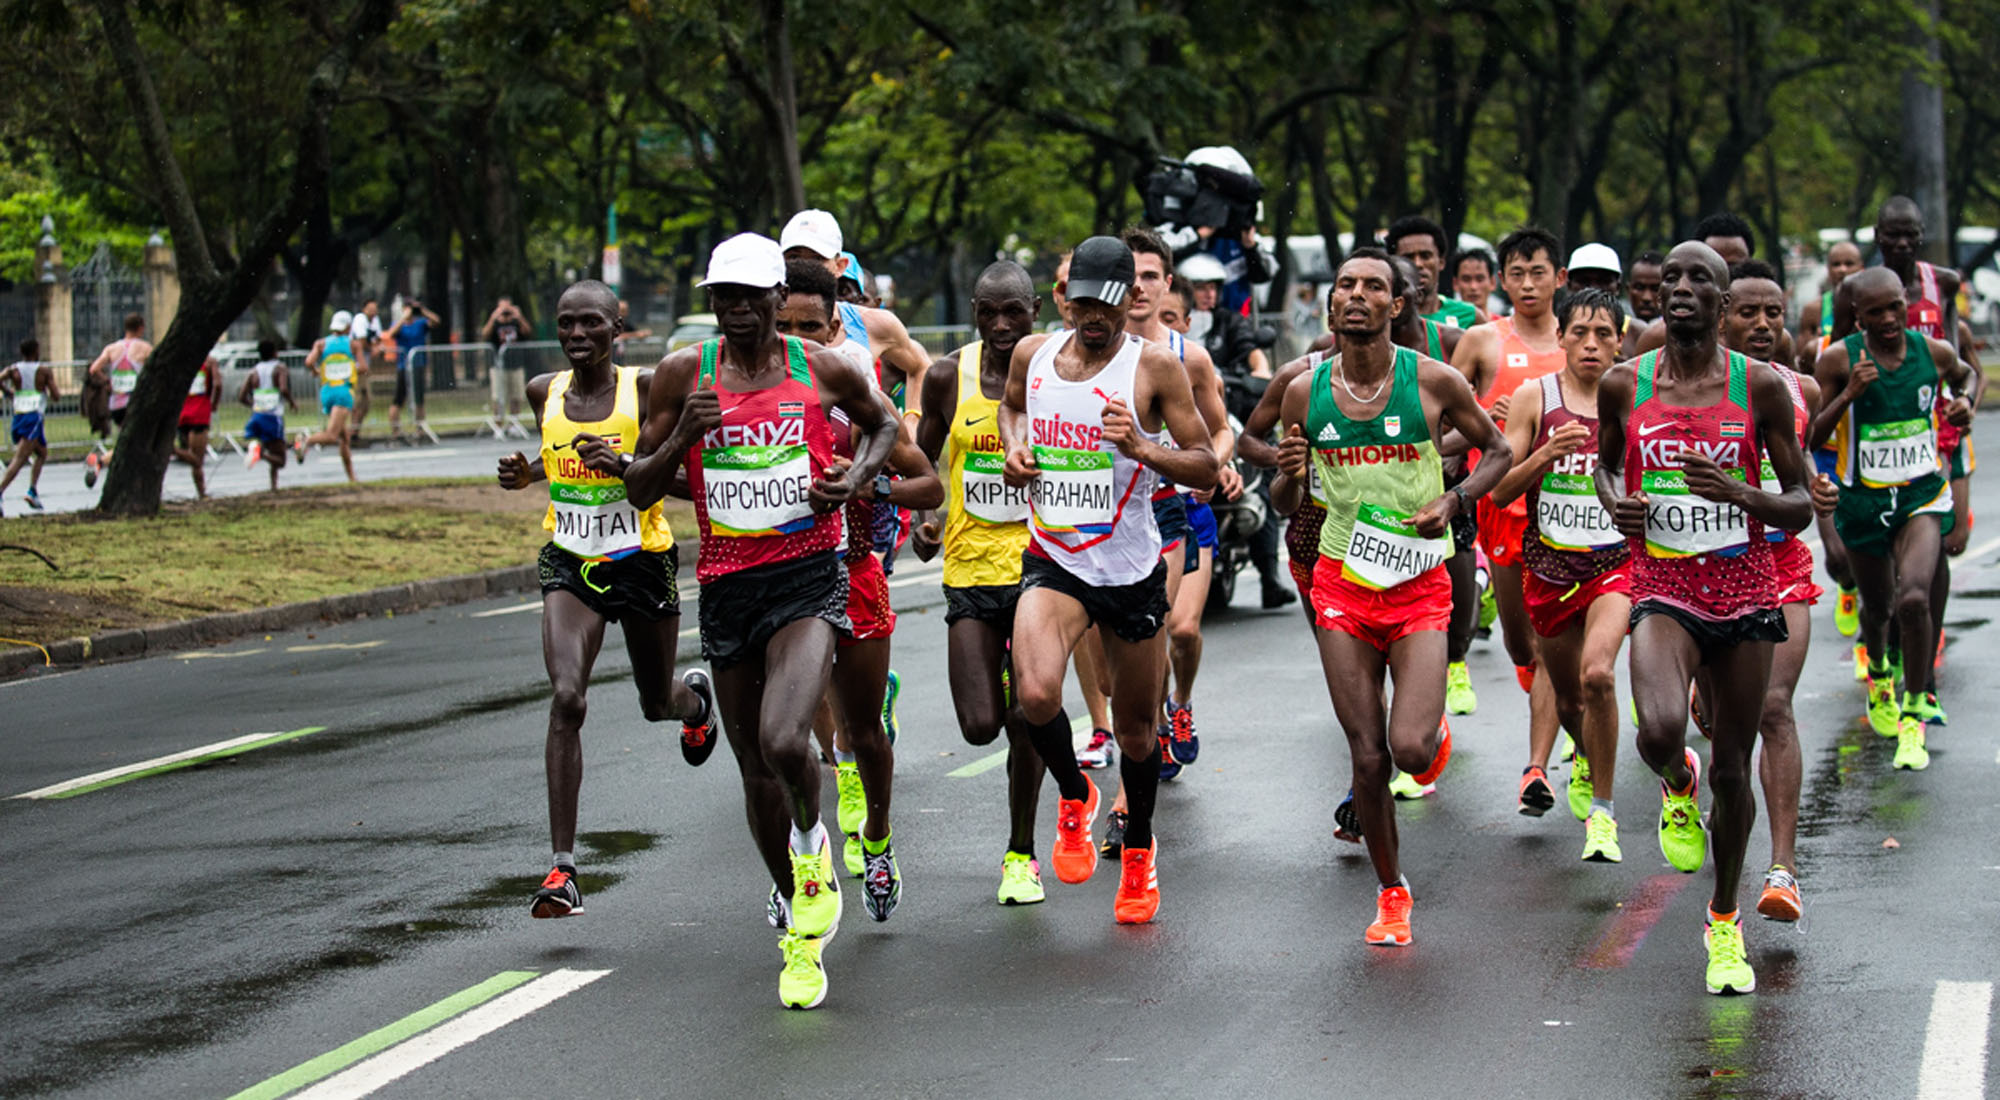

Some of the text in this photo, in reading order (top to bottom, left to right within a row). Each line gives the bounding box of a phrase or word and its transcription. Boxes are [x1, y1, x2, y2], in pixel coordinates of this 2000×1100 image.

[703, 419, 805, 450] KENYA
[1861, 443, 1933, 469] NZIMA
[706, 474, 810, 510] KIPCHOGE
[556, 509, 637, 539] MUTAI
[1540, 501, 1619, 531] PACHEC
[1646, 502, 1745, 533] KORIR
